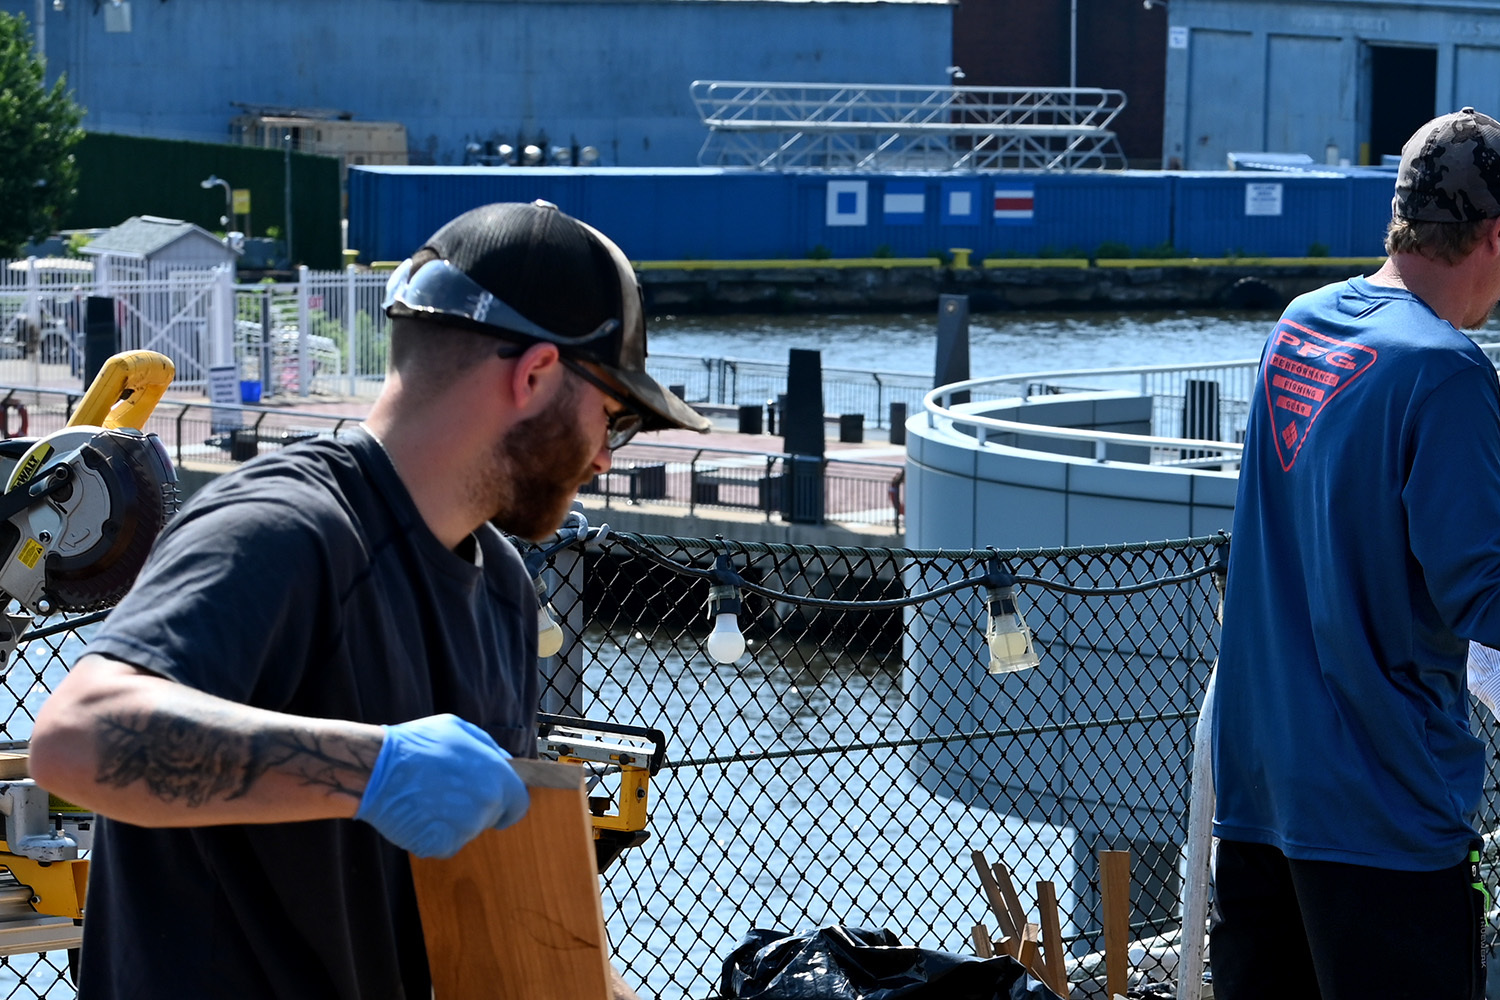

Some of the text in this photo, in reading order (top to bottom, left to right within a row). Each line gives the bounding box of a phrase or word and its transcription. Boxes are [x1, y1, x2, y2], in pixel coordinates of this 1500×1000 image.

[1274, 330, 1358, 371] PFG
[1272, 356, 1336, 385] PERFORMANCE
[1283, 380, 1317, 398] FISHING
[1285, 400, 1306, 414] GEAR
